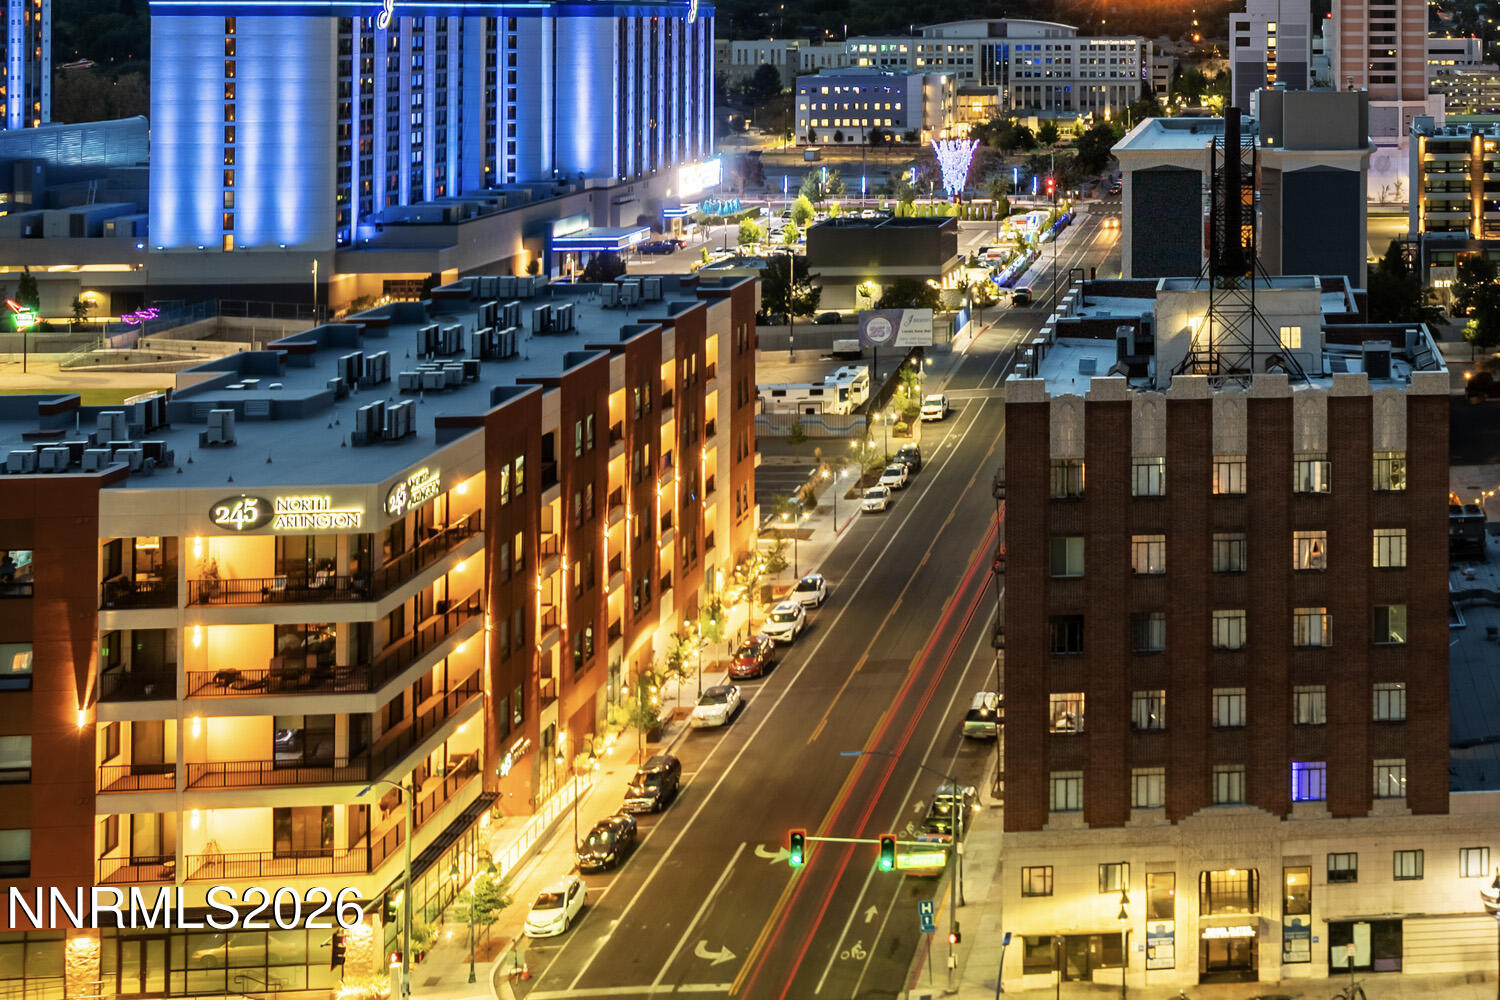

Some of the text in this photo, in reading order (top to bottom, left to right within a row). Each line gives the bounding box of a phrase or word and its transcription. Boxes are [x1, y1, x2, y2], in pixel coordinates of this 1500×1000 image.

[276, 496, 330, 511] NORTH
[214, 498, 258, 530] 245
[275, 512, 361, 529] ARLINGTON
[921, 902, 932, 914] H
